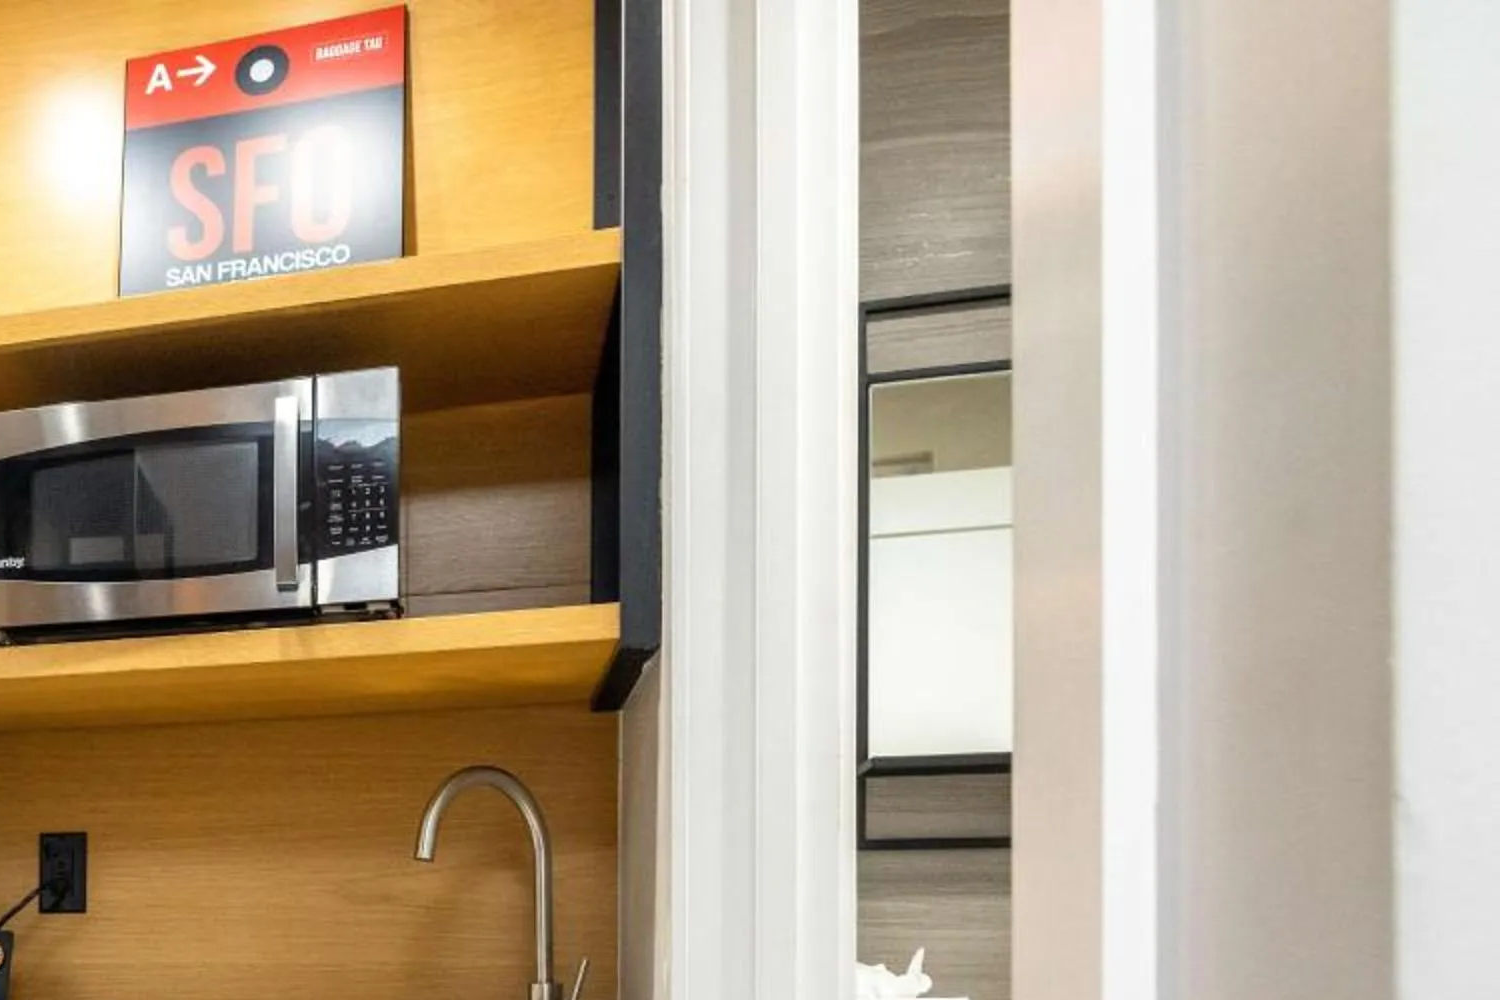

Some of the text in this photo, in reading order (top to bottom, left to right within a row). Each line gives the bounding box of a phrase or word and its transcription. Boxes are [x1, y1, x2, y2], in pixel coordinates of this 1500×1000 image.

[145, 64, 173, 95] A
[168, 124, 352, 262] SFO
[166, 243, 351, 287] SAN FRANCISCO
